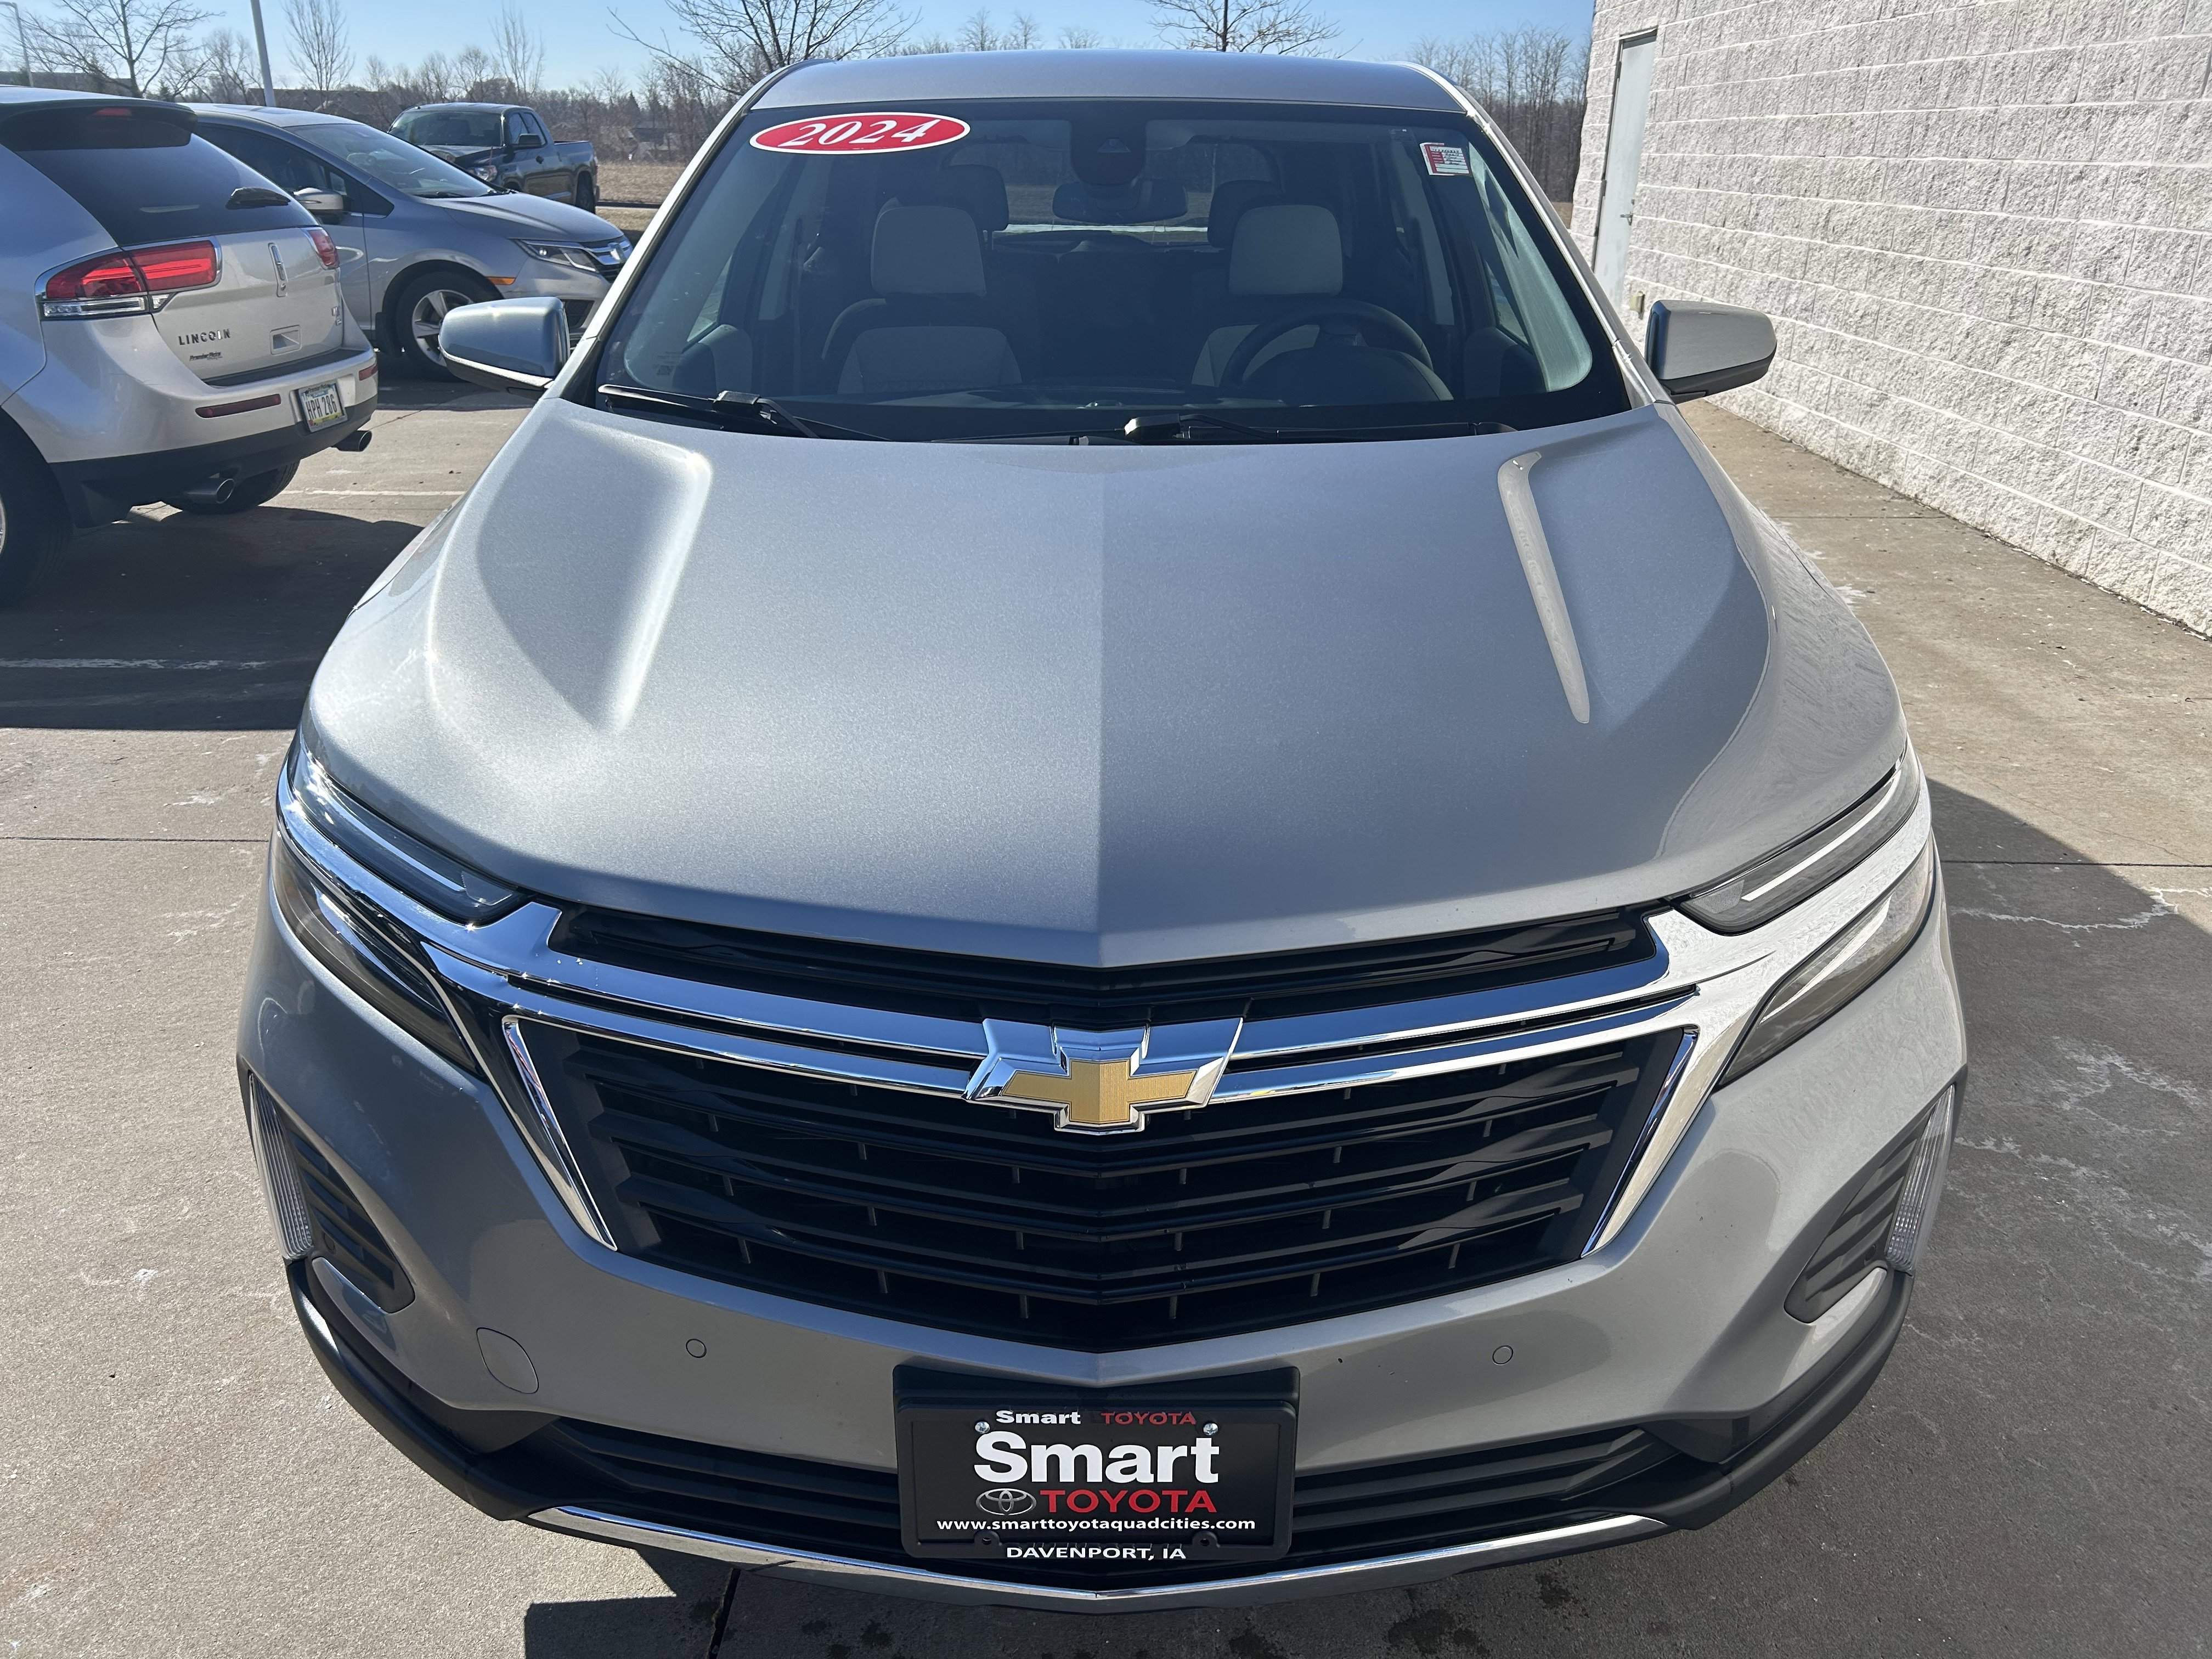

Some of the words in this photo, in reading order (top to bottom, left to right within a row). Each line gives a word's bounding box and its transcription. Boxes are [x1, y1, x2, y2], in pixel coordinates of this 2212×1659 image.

[777, 119, 941, 146] 2024
[178, 329, 230, 345] LINCOLN
[306, 398, 323, 420] HPH
[321, 394, 337, 415] 286
[996, 1410, 1081, 1425] Smart
[1101, 1412, 1196, 1425] TOYOTA
[974, 1431, 1220, 1483] Smart
[1040, 1489, 1217, 1513] TOYOTA
[936, 1517, 1255, 1531] www.smarttoyotaquadcities.com
[1007, 1547, 1154, 1560] DAVENPORT,
[1163, 1548, 1186, 1559] IA
